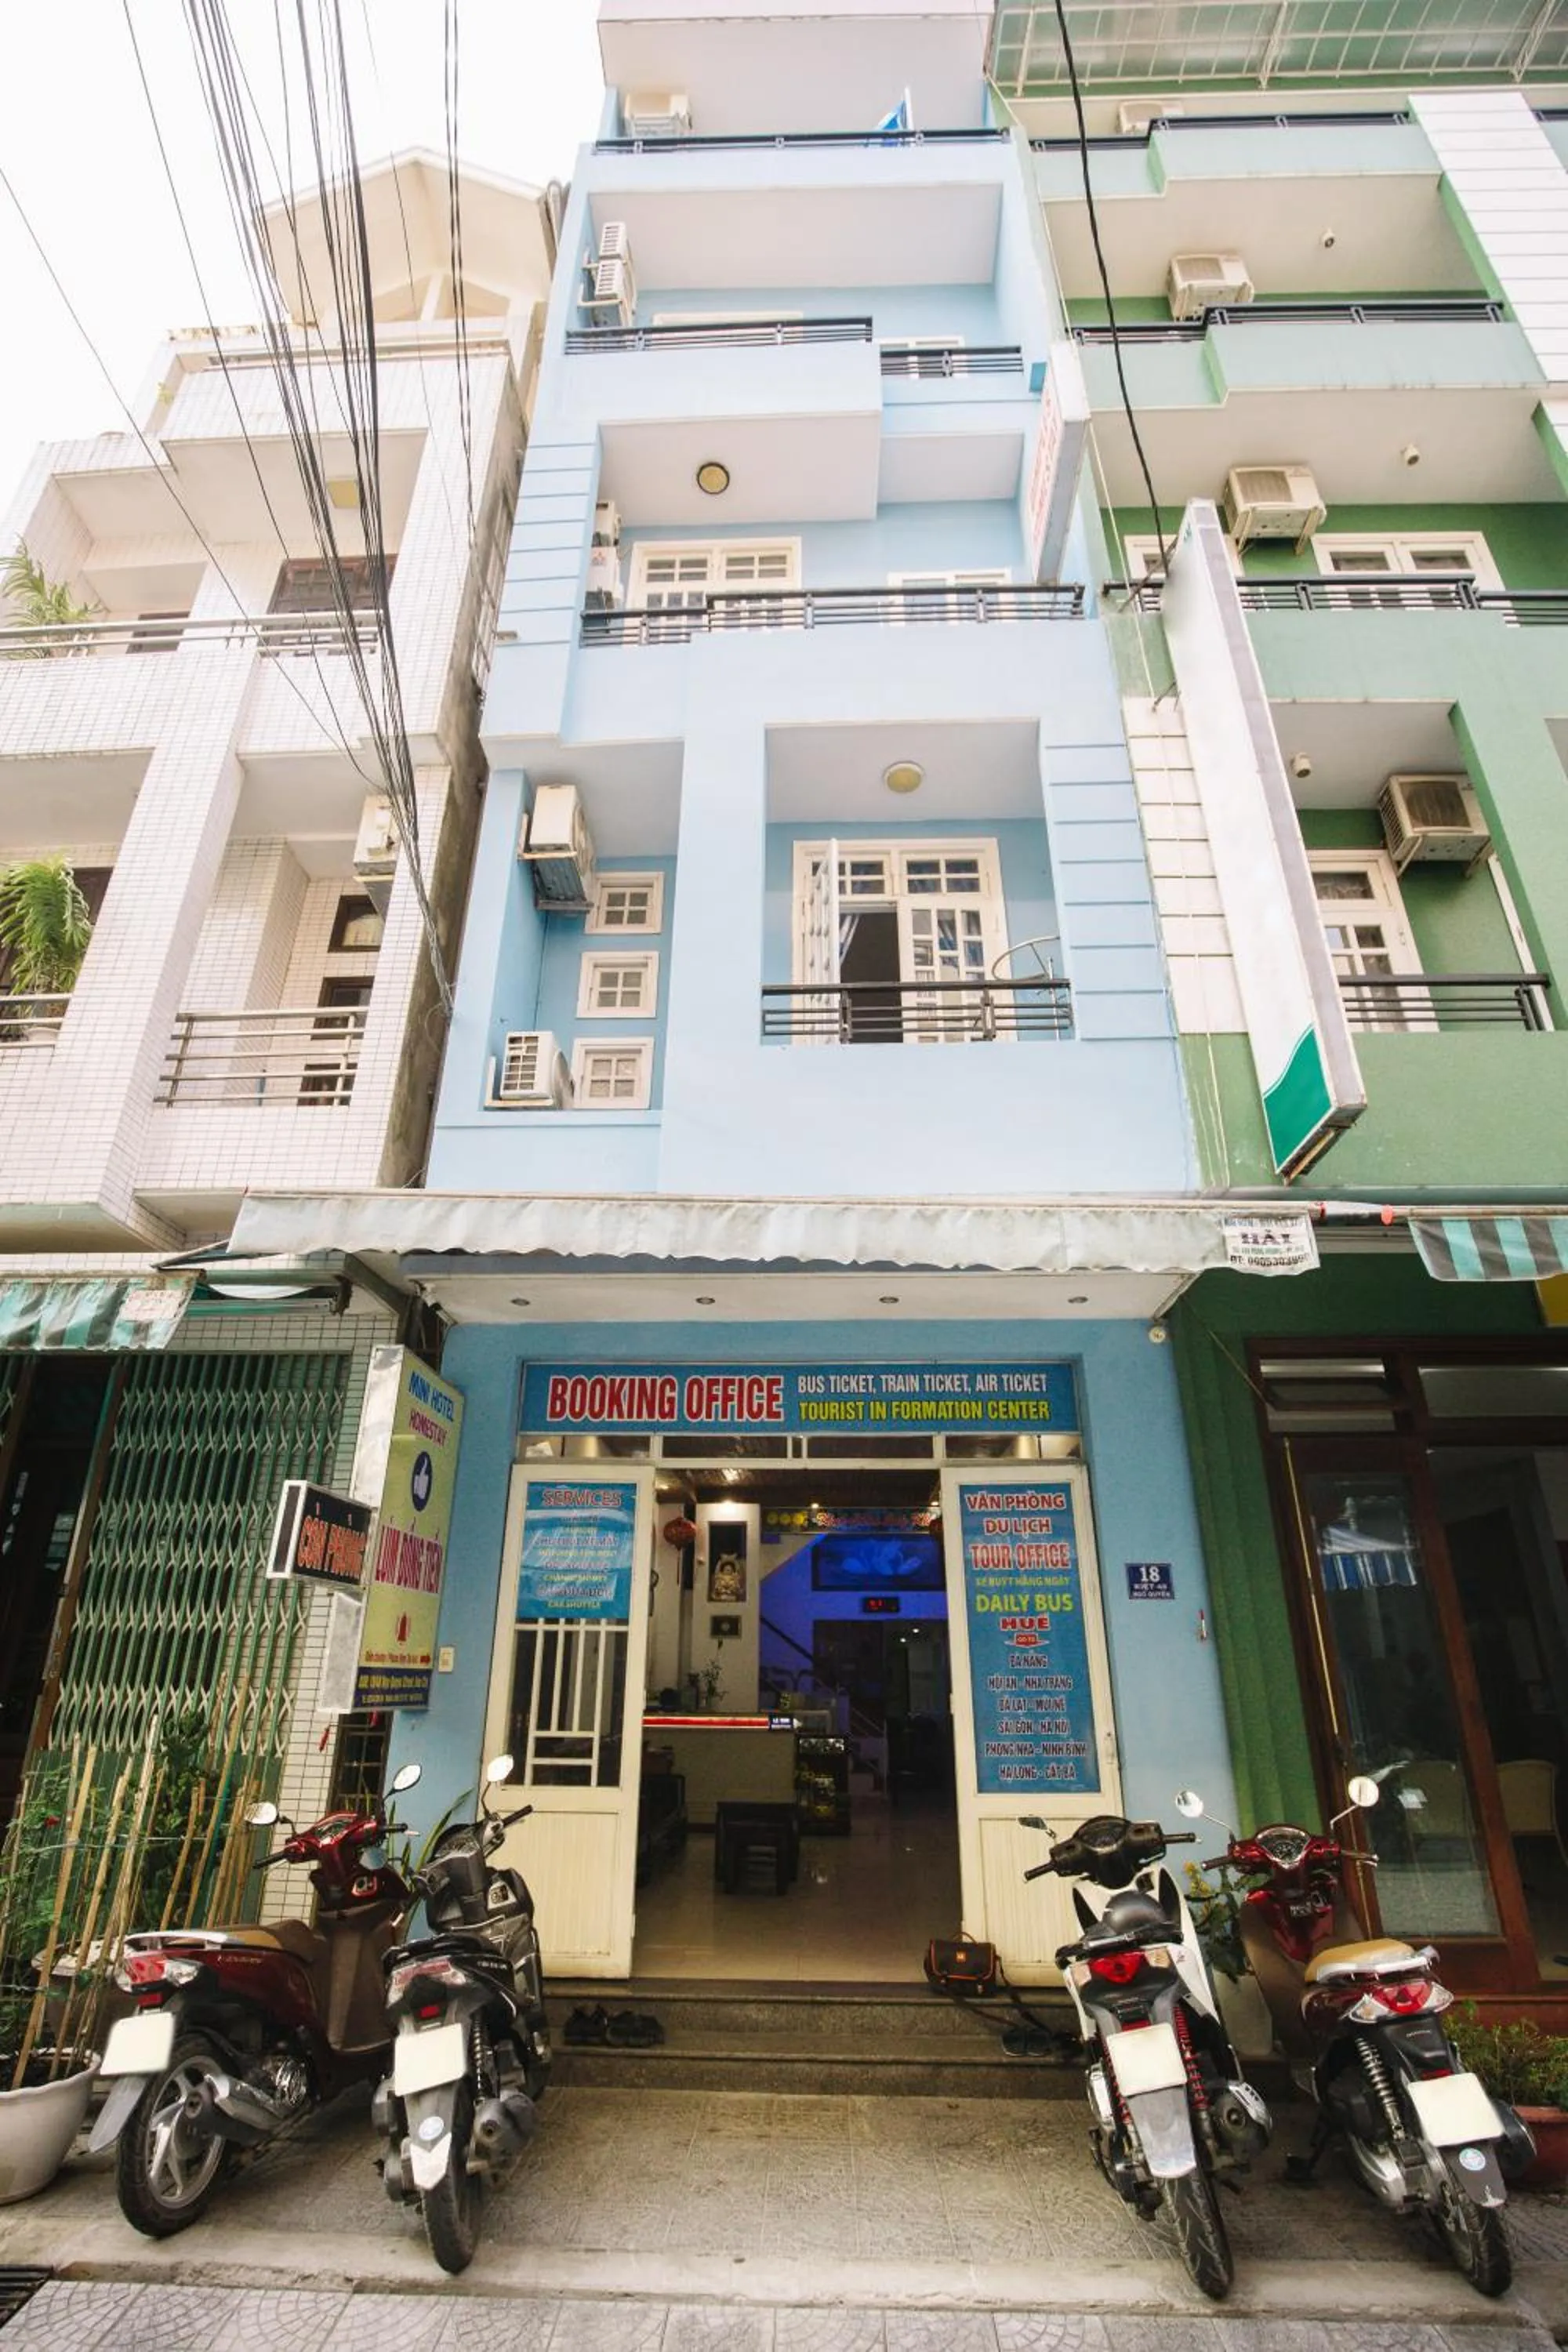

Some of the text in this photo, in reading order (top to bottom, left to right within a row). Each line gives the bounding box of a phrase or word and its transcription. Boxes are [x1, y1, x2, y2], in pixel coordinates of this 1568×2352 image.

[798, 1374, 1047, 1395] BUS TICKET, TRAIN TICKET, AIR TICKET
[408, 1370, 455, 1422] MINI HOTEL
[547, 1375, 784, 1422] BOOKING OFFICE
[799, 1400, 1050, 1421] TOURIST IN FORMATION CENTER
[408, 1407, 448, 1446] HOMESTAY
[543, 1489, 623, 1507] SERVICES
[984, 1518, 1010, 1535] DU
[971, 1542, 1071, 1570] TOUR OFFICE
[1139, 1566, 1160, 1583] 18
[975, 1592, 1074, 1612] DAILY BUS
